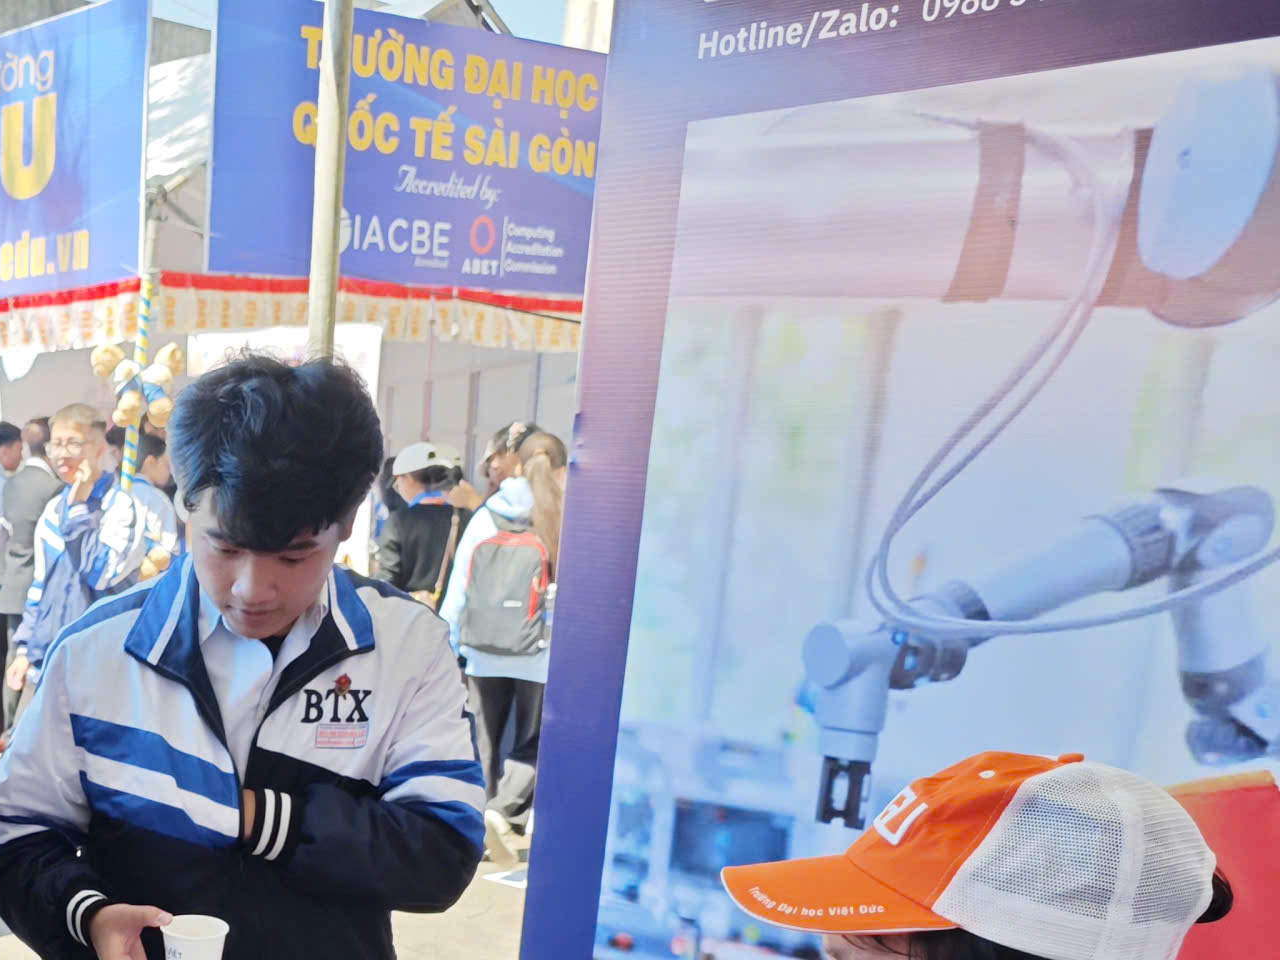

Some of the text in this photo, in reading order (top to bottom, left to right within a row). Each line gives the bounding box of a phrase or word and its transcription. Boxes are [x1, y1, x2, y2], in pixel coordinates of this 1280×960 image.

[697, 4, 899, 60] Hotline/Zalo:
[300, 25, 600, 120] TƯỜNG ĐẠI HỌC
[292, 92, 597, 178] QỐC TẾ SÀI GÒN
[394, 163, 480, 201] Accredited
[353, 214, 453, 258] IACBE
[461, 258, 499, 276] ABET
[300, 689, 372, 723] BTX
[801, 907, 824, 918] học
